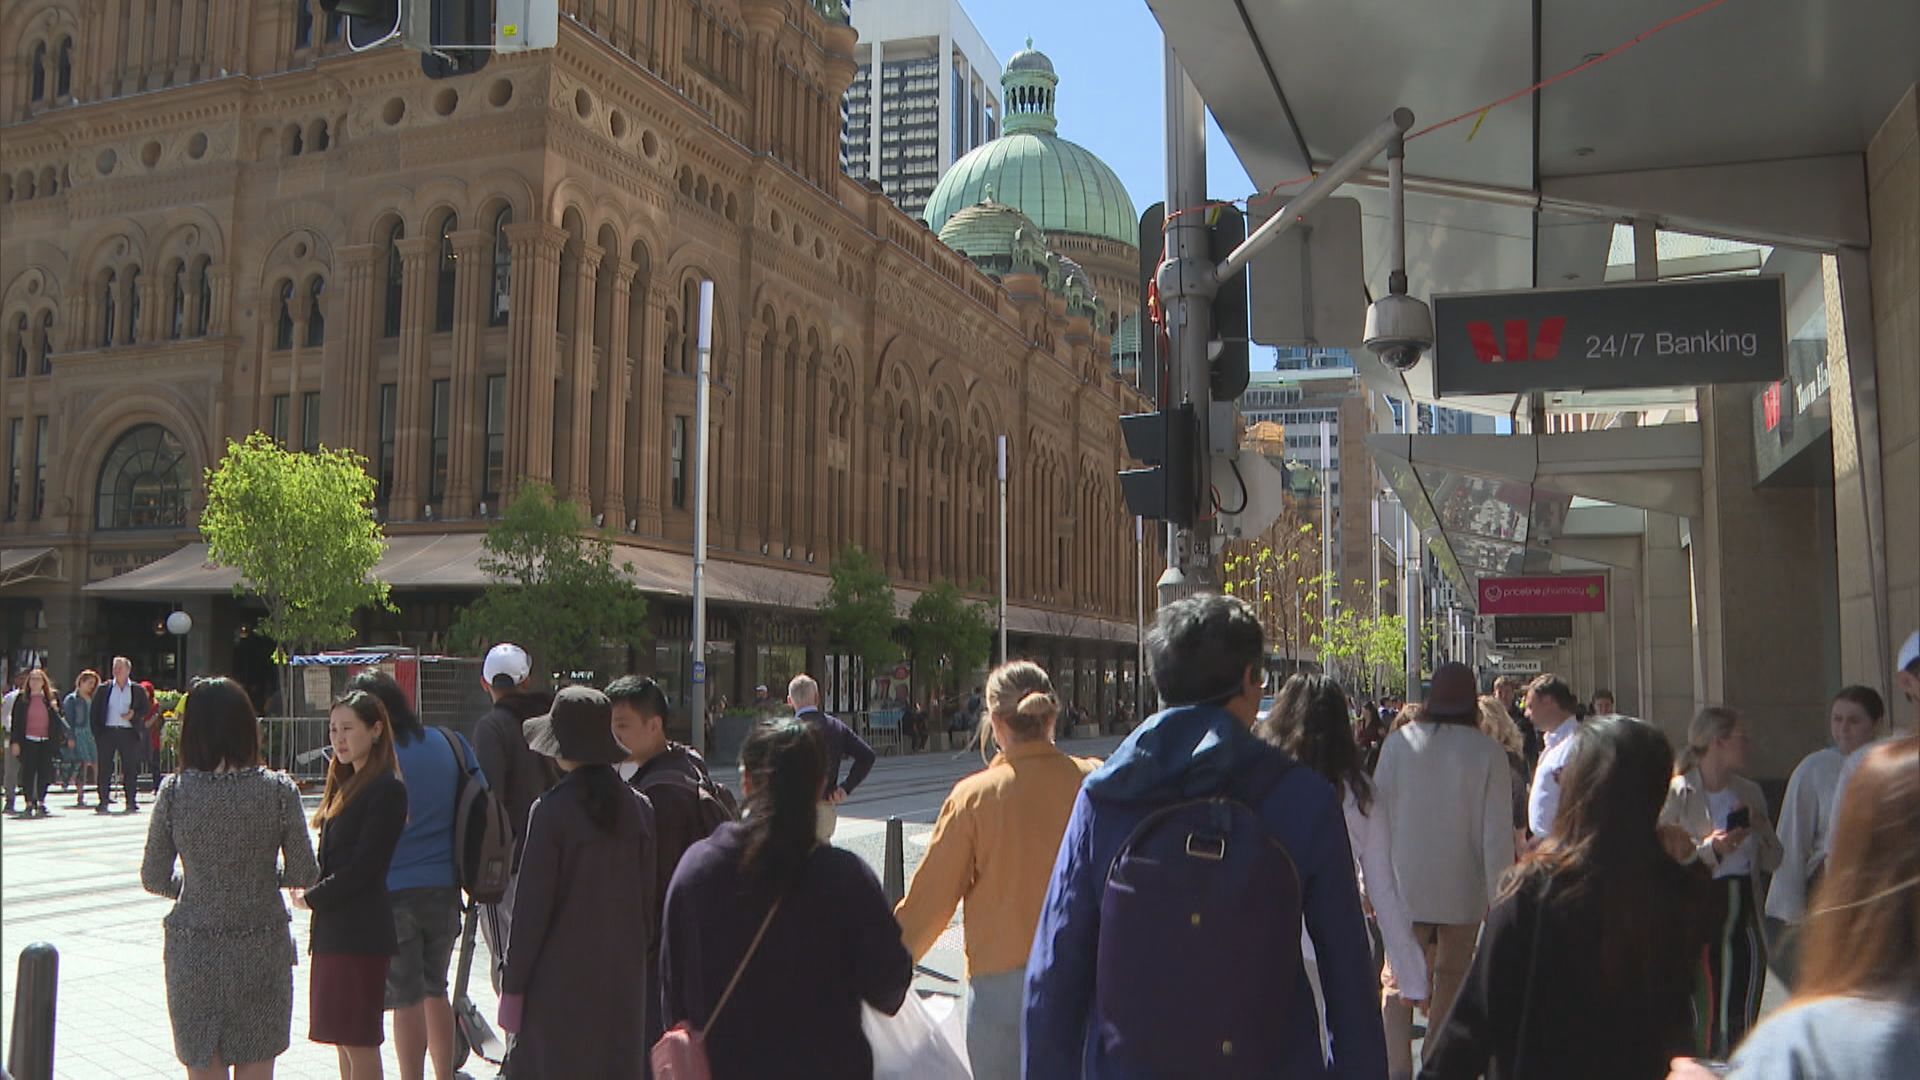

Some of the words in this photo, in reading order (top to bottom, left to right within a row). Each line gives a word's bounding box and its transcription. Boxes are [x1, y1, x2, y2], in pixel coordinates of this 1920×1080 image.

[1586, 333, 1645, 358] 24/7
[1655, 328, 1757, 357] Banking
[1796, 381, 1817, 415] Town
[1816, 357, 1830, 397] Hal
